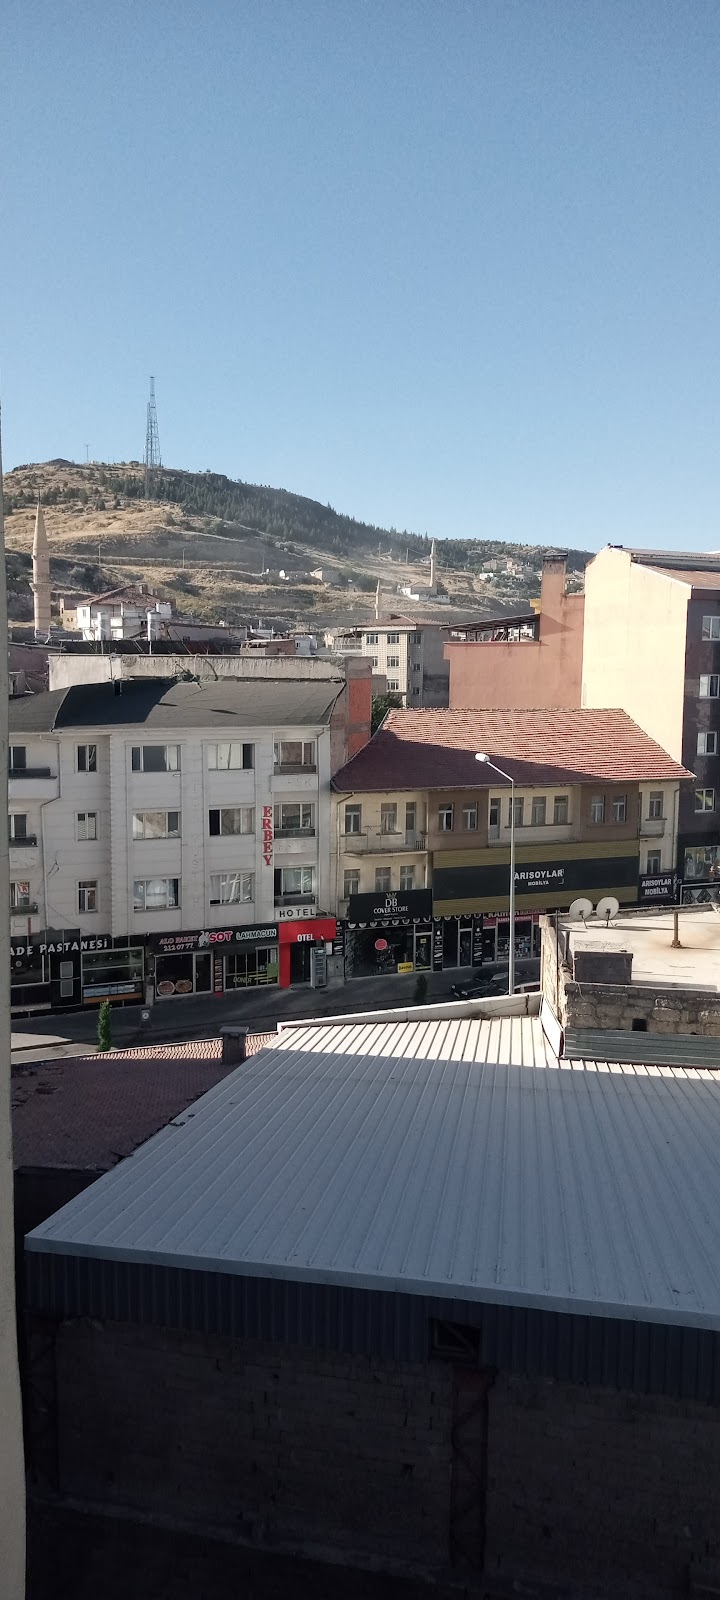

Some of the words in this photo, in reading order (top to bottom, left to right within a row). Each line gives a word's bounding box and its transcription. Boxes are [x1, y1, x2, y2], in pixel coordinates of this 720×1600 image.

[261, 806, 273, 866] ERBEY
[514, 869, 563, 880] ARISOYLAR
[641, 878, 672, 887] ARISOYLAR
[385, 898, 398, 907] DB
[279, 909, 315, 918] HOTEL
[392, 905, 409, 913] STORE
[209, 930, 233, 942] SOT
[236, 928, 277, 940] LAHMACUN
[297, 933, 314, 942] OTEL
[159, 937, 174, 945] ALO
